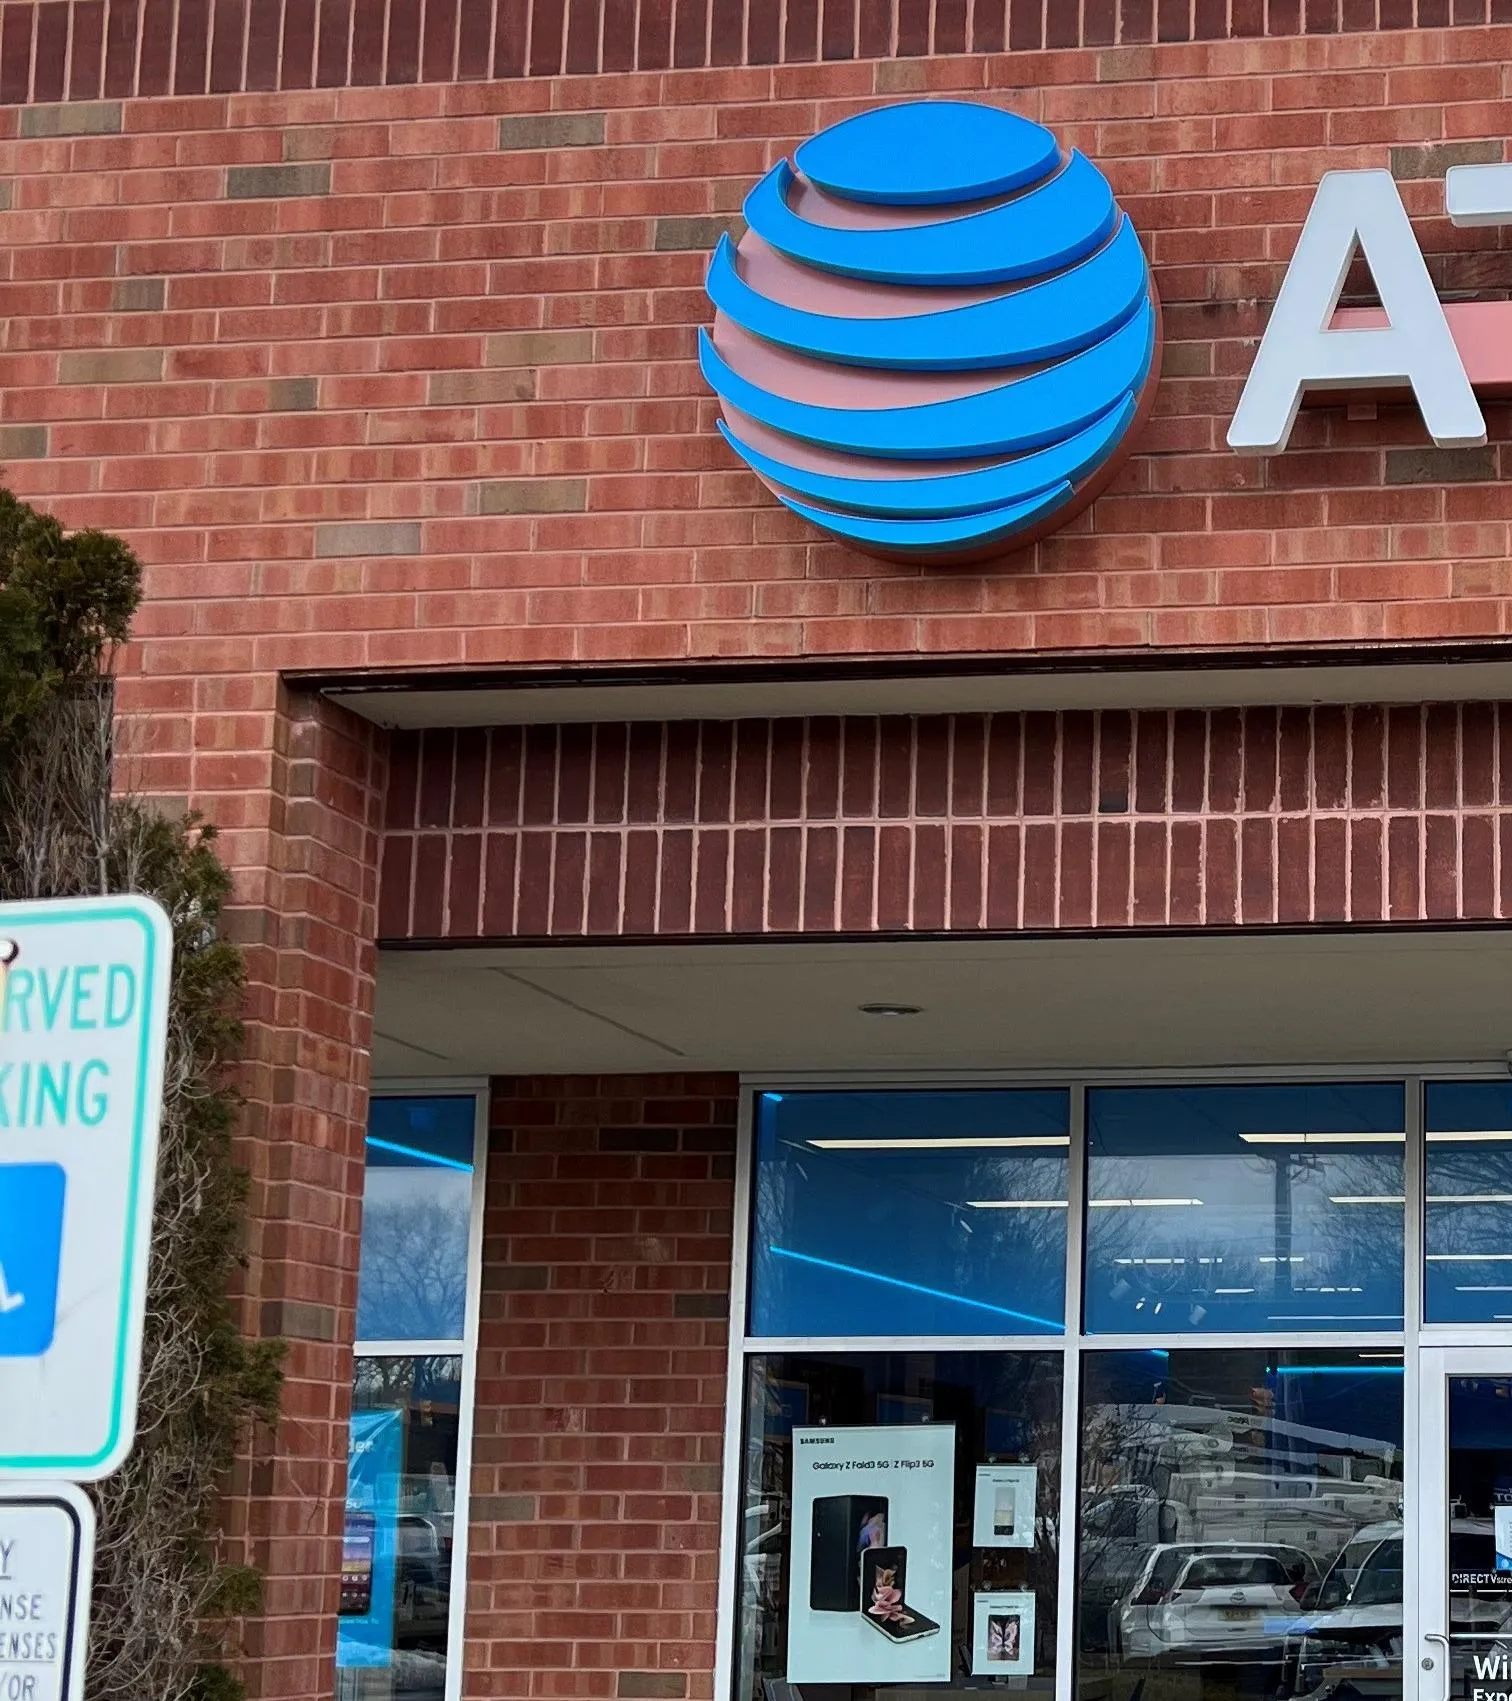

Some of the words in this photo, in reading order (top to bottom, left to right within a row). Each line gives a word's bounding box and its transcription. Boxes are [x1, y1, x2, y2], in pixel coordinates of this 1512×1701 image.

[812, 1461, 843, 1471] Galaxy
[845, 1461, 851, 1470] Z
[852, 1461, 875, 1469] Fold3
[877, 1461, 889, 1469] 5G
